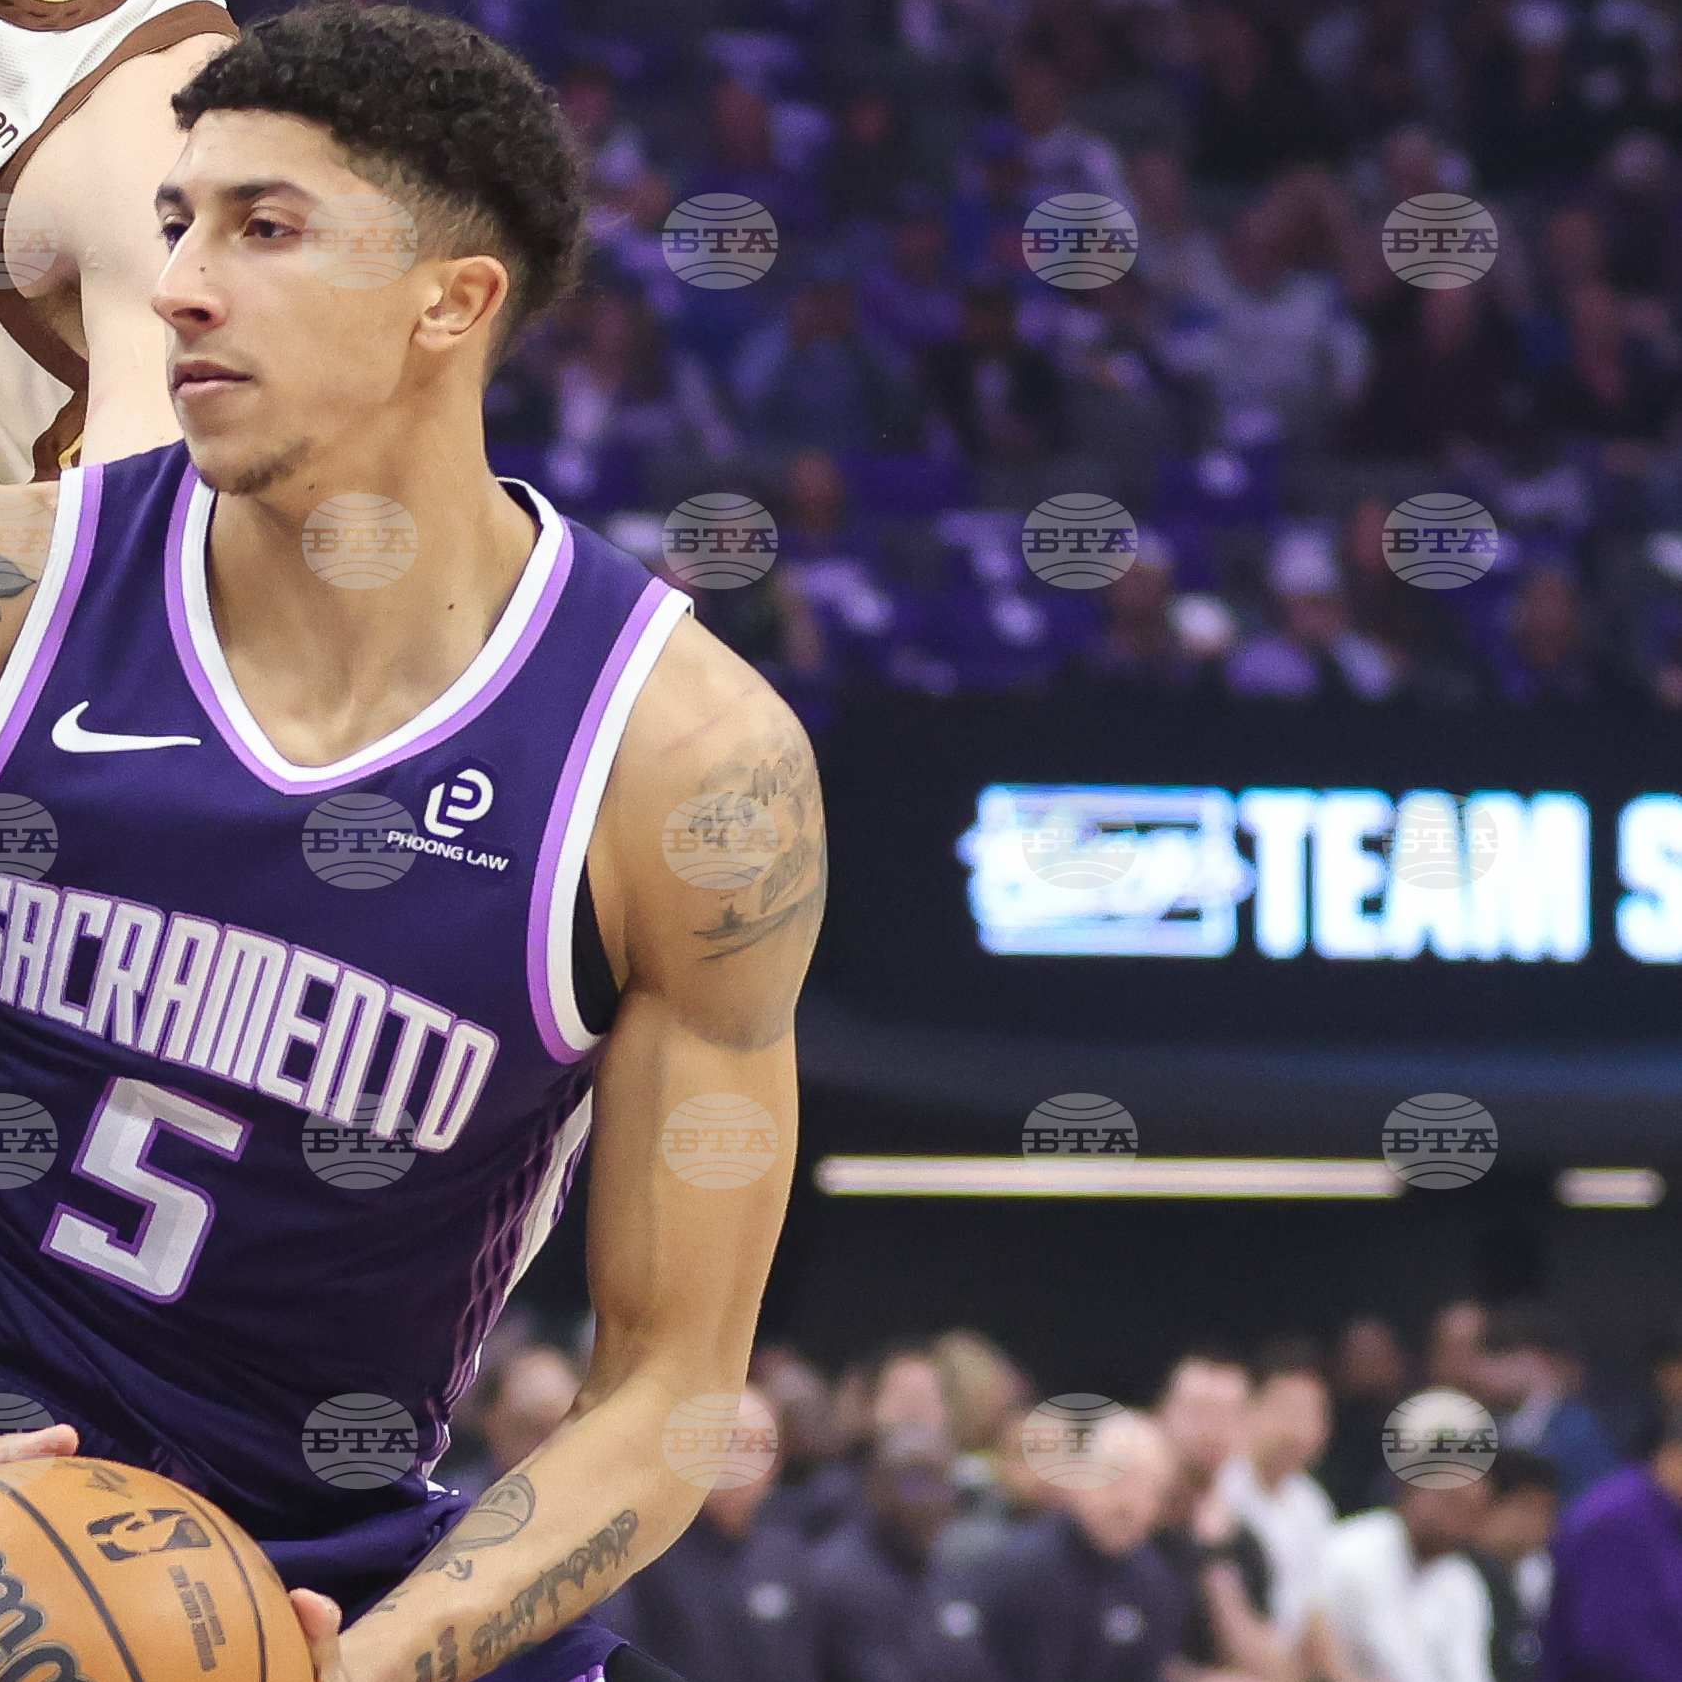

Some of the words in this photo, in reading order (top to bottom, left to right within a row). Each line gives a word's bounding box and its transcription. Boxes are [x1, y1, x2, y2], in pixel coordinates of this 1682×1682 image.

[386, 830, 465, 862] PHOONG
[466, 849, 510, 872] LAW
[1237, 786, 1593, 963] TEAM
[42, 1077, 253, 1303] 5
